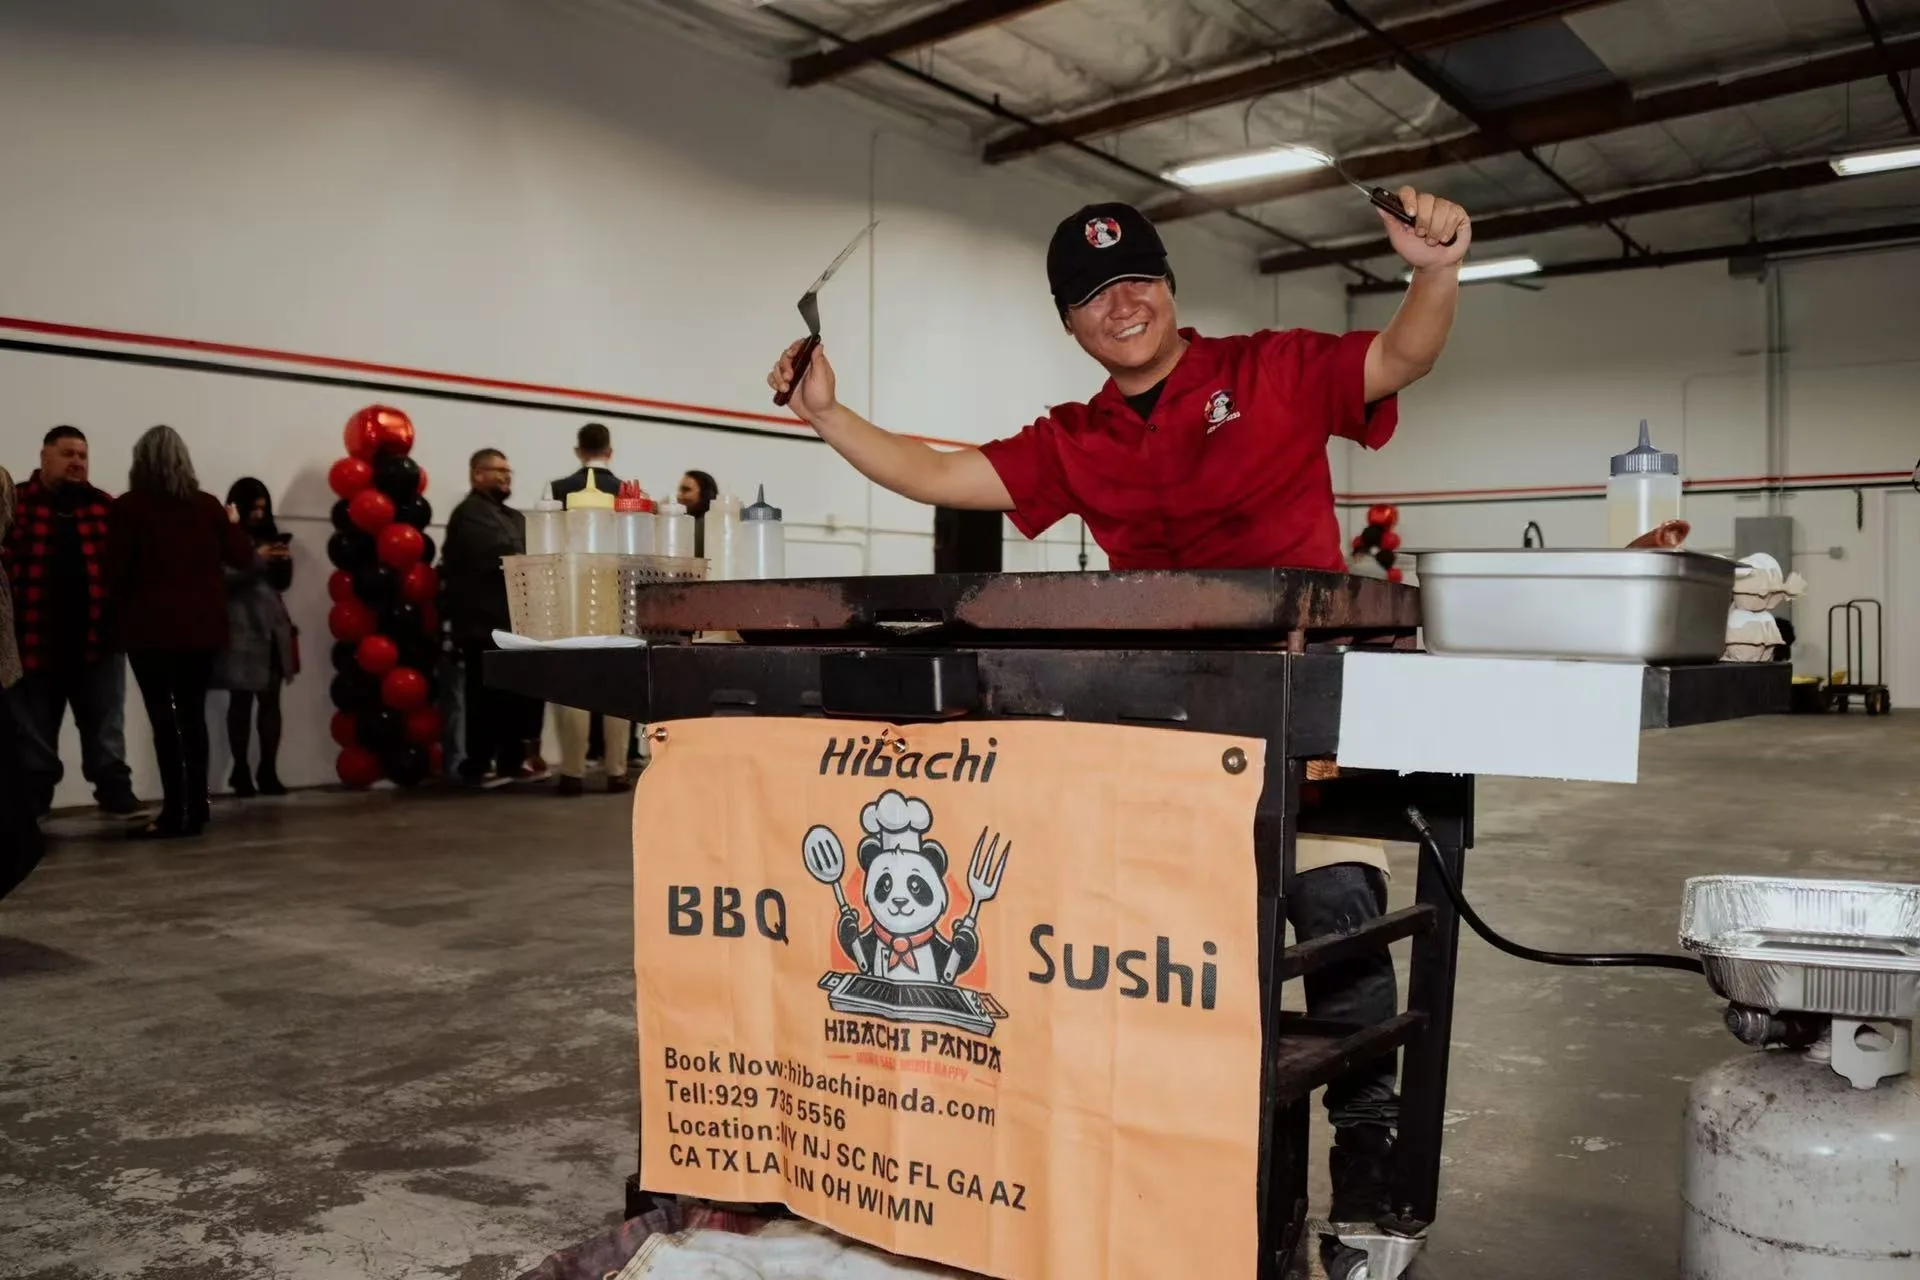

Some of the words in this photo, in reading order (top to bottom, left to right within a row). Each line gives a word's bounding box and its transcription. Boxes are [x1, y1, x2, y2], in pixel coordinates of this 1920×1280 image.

[818, 735, 998, 783] Hibachi
[668, 885, 789, 945] BBQ
[1028, 923, 1217, 1010] Sushi
[665, 1047, 721, 1073] Book
[824, 1018, 911, 1052] HIBACHI
[921, 1030, 1002, 1073] PANDA
[766, 1087, 793, 1116] 735
[797, 1099, 846, 1131] 5556
[669, 1144, 701, 1168] CA
[706, 1148, 739, 1172] TX
[746, 1151, 781, 1174] LA
[821, 1173, 850, 1204] OH
[803, 1134, 831, 1161] NJ
[837, 1143, 865, 1171] SC
[872, 1152, 899, 1183] NC
[909, 1160, 939, 1190] FL
[947, 1169, 984, 1201] GA
[989, 1180, 1027, 1211] AZ
